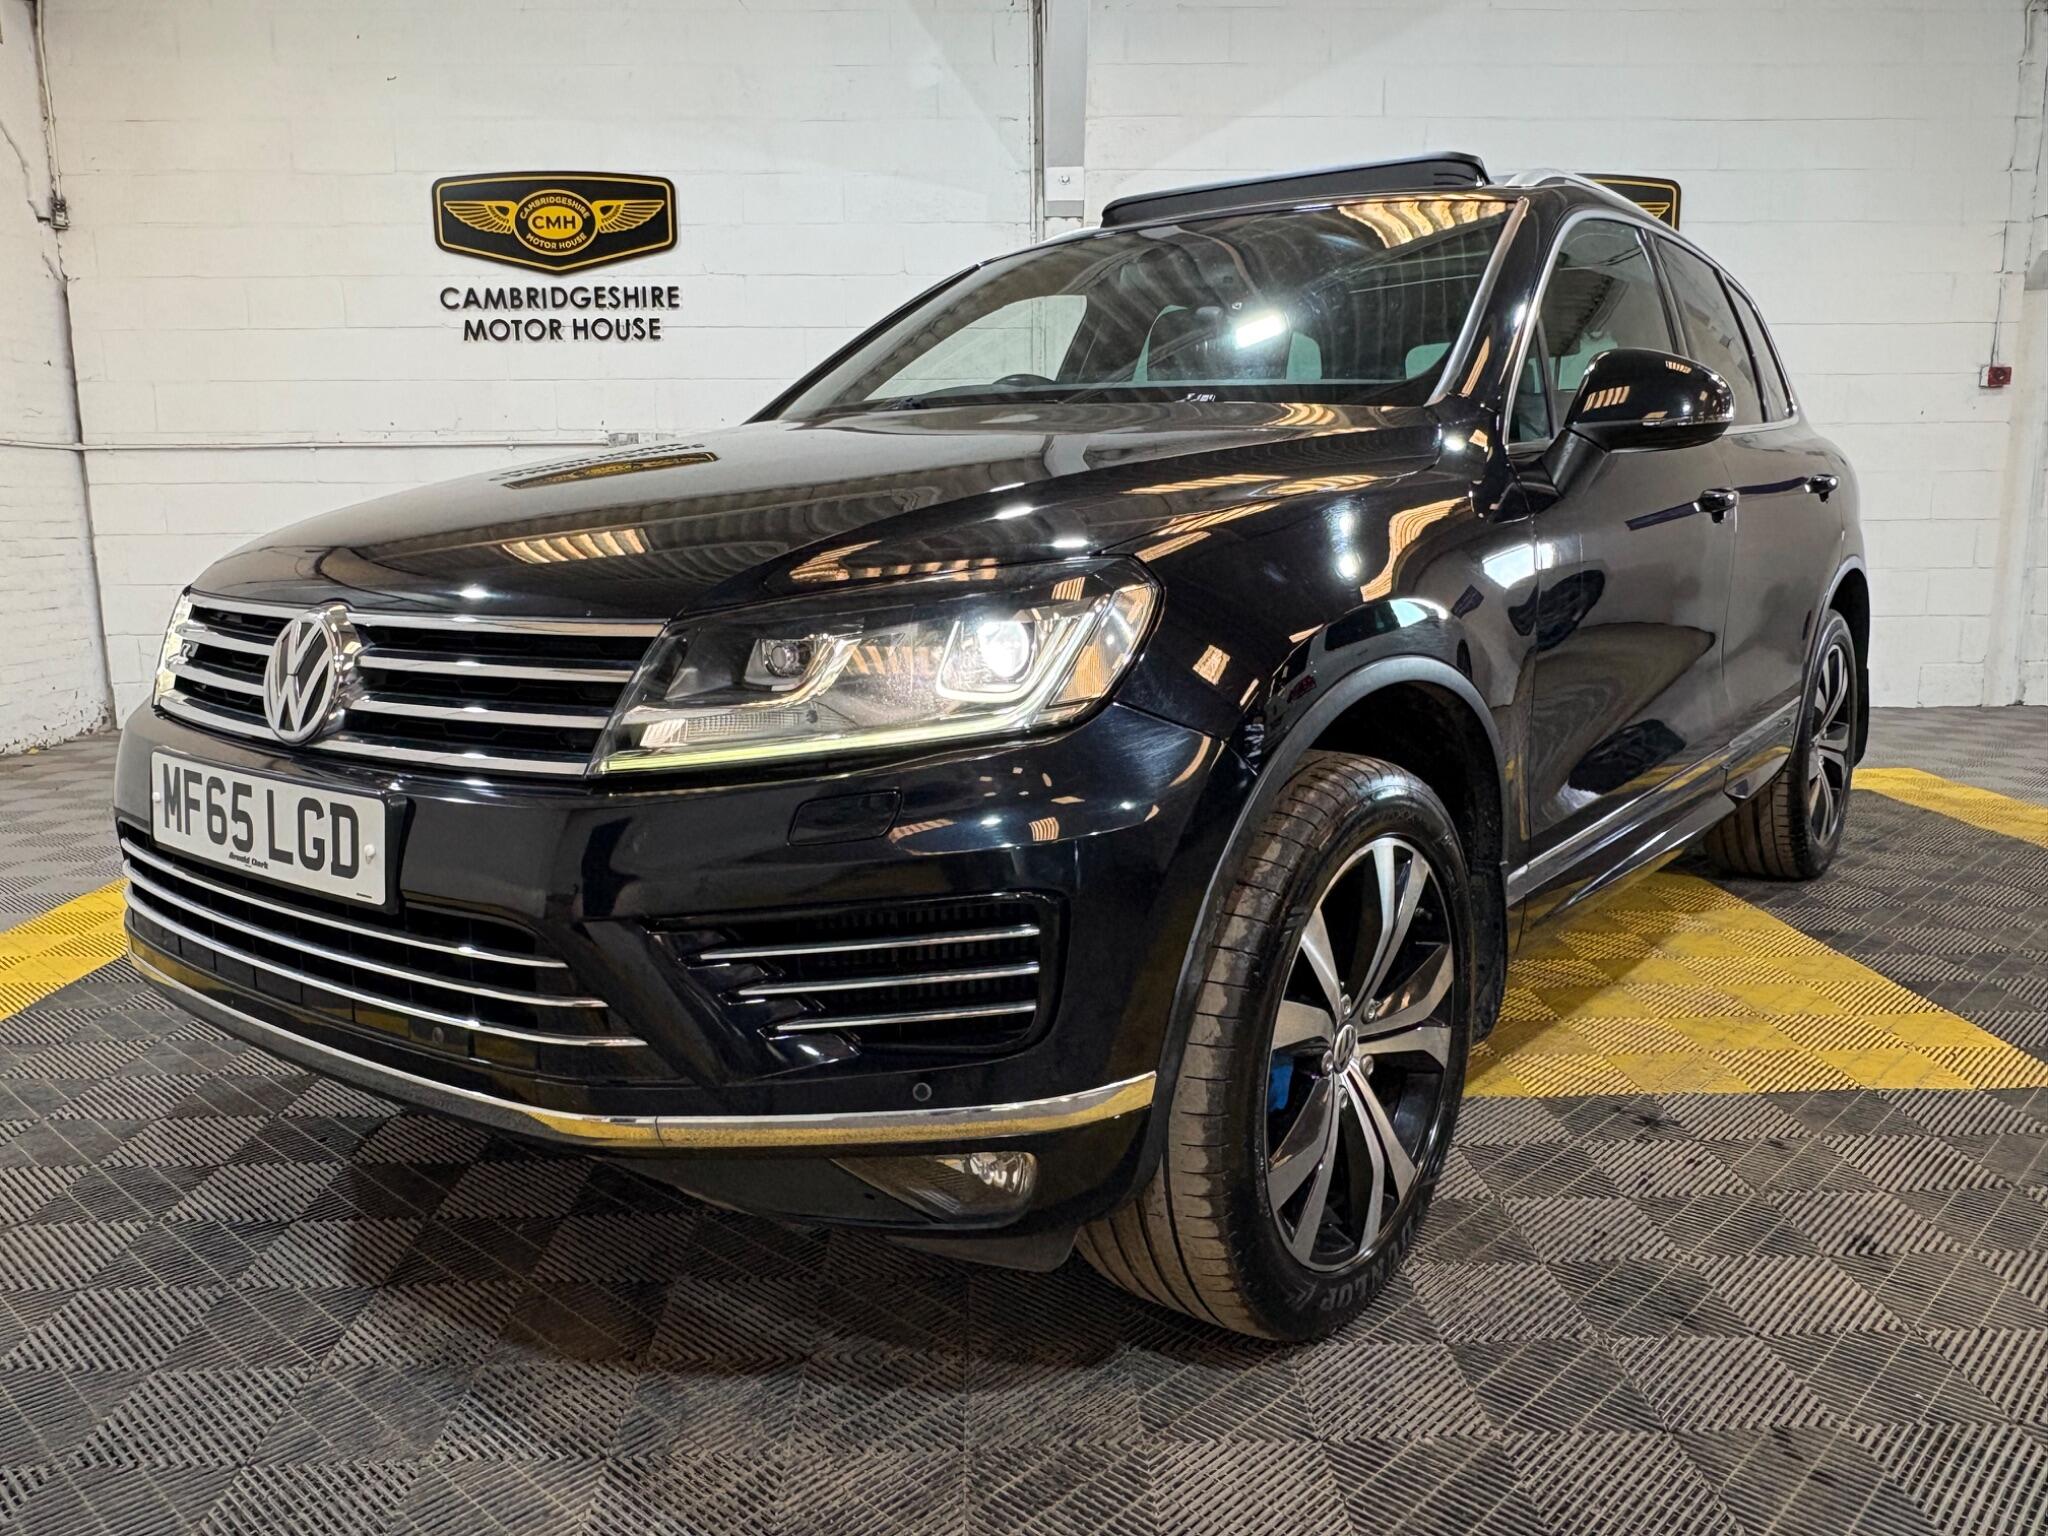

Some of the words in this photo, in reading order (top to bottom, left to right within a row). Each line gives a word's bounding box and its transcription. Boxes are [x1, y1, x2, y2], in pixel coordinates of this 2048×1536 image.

[519, 195, 591, 219] CAMBRIDGESHIRE
[531, 215, 577, 230] CMH
[525, 232, 557, 250] MOTOR
[558, 232, 588, 249] HOUSE
[440, 286, 680, 310] CAMBRIDGESHIRE
[463, 318, 564, 342] MOTOR
[572, 317, 662, 341] HOUSE
[162, 762, 254, 854] MF65
[266, 788, 360, 880] LGD
